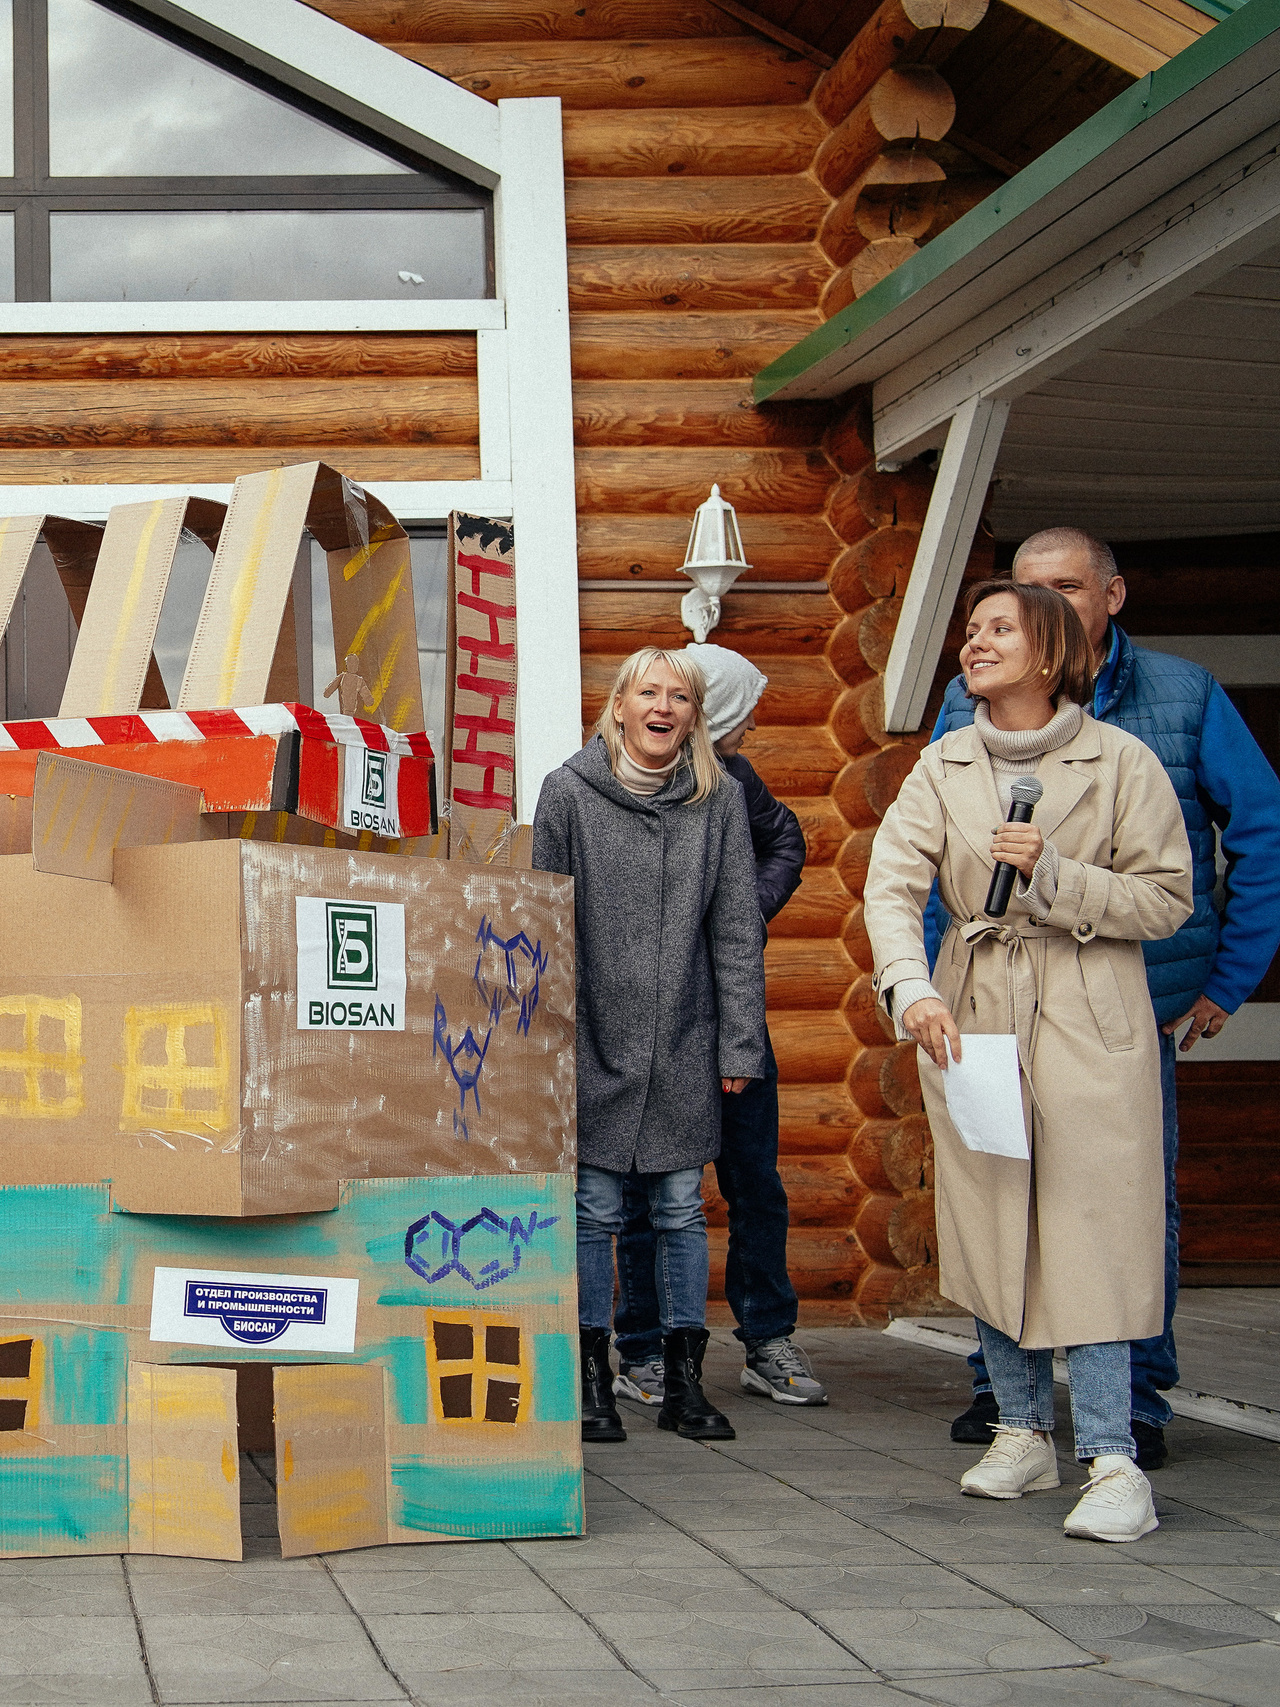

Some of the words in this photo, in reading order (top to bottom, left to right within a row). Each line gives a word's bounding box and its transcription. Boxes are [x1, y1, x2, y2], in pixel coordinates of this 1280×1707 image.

[350, 809, 396, 834] BIOSAN
[308, 1000, 395, 1026] BIOSAN
[195, 1287, 232, 1299] ОТДЕЛ
[233, 1290, 319, 1304] ПРОИЗВОДСТВА
[197, 1299, 206, 1309] И
[207, 1300, 315, 1315] ПРОМЫШЛЕННОСТИ
[233, 1320, 276, 1334] БИОСАН
